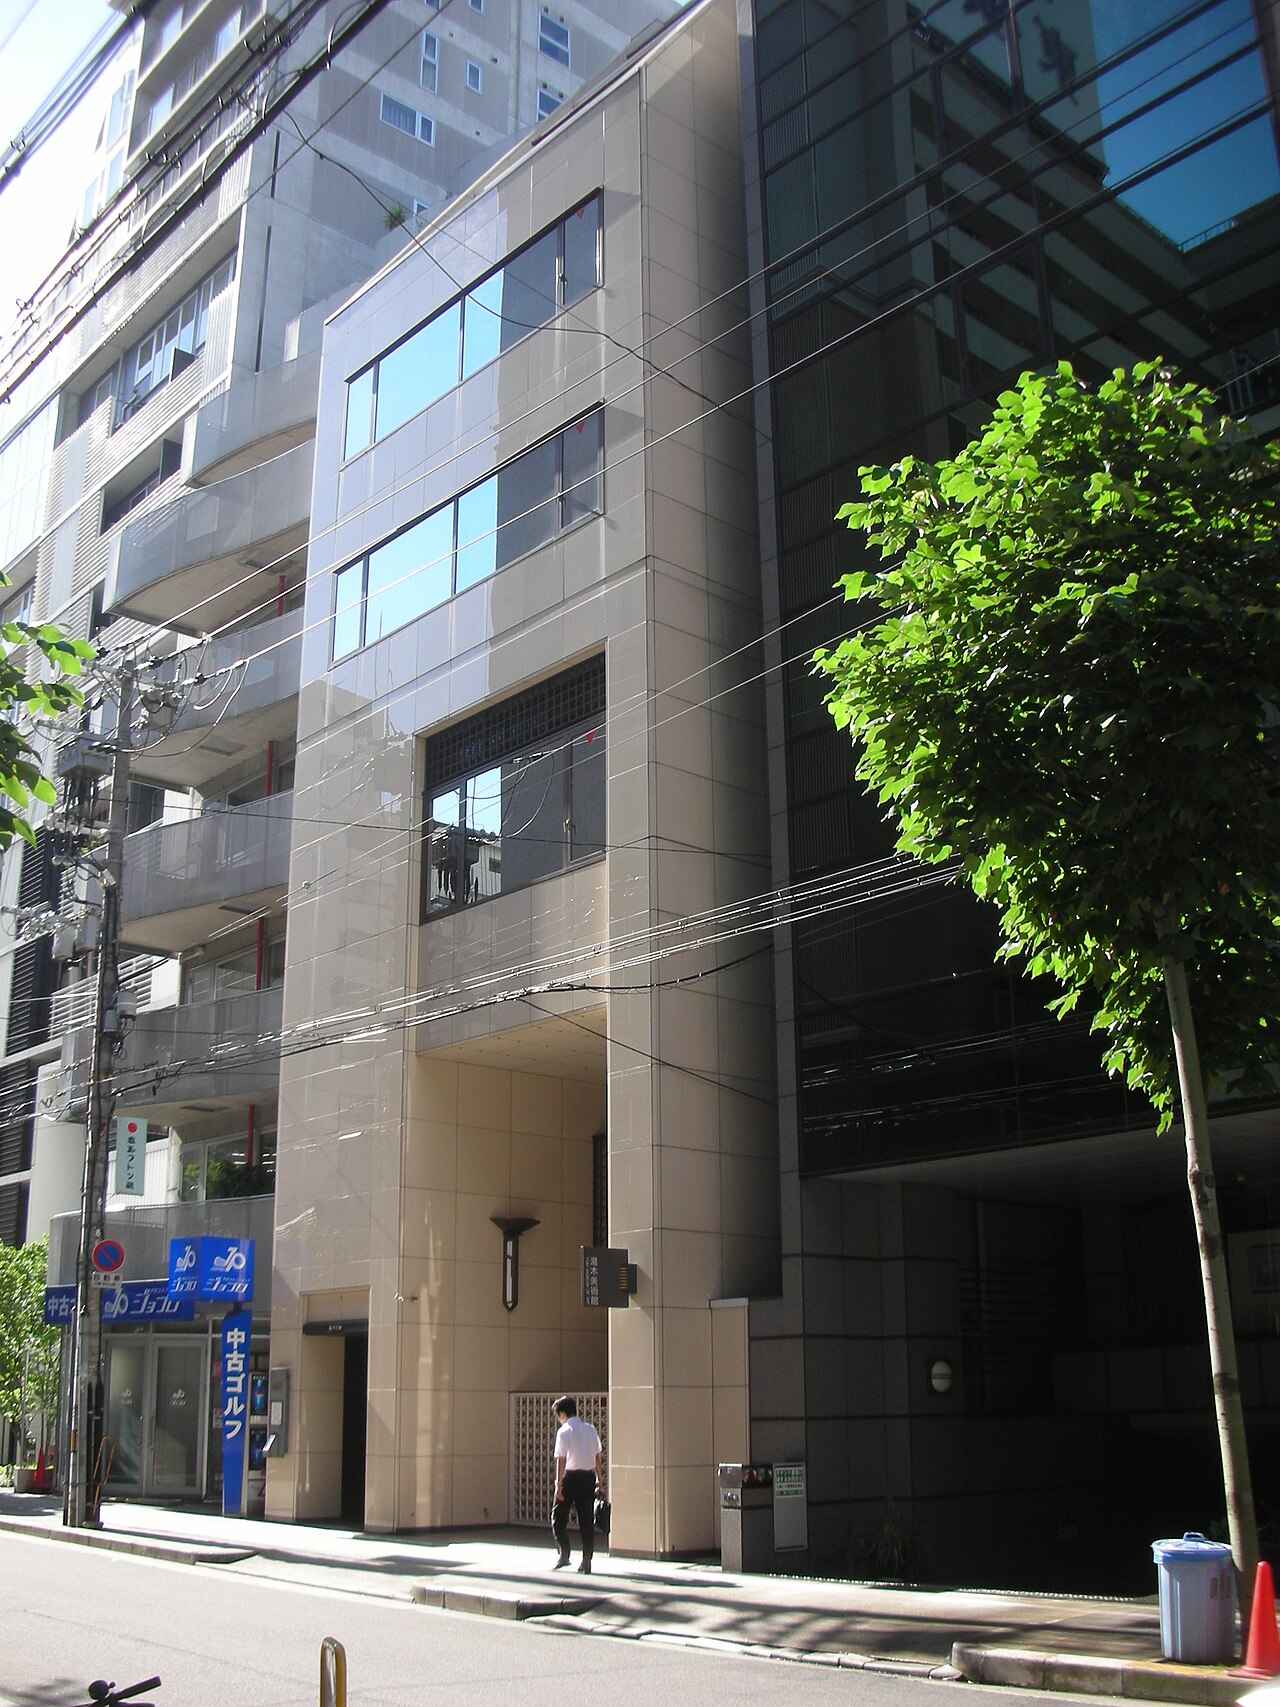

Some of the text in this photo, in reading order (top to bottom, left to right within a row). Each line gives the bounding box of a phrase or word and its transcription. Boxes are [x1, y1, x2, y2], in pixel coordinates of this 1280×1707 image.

[223, 1327, 246, 1440] 中古ゴルフ
